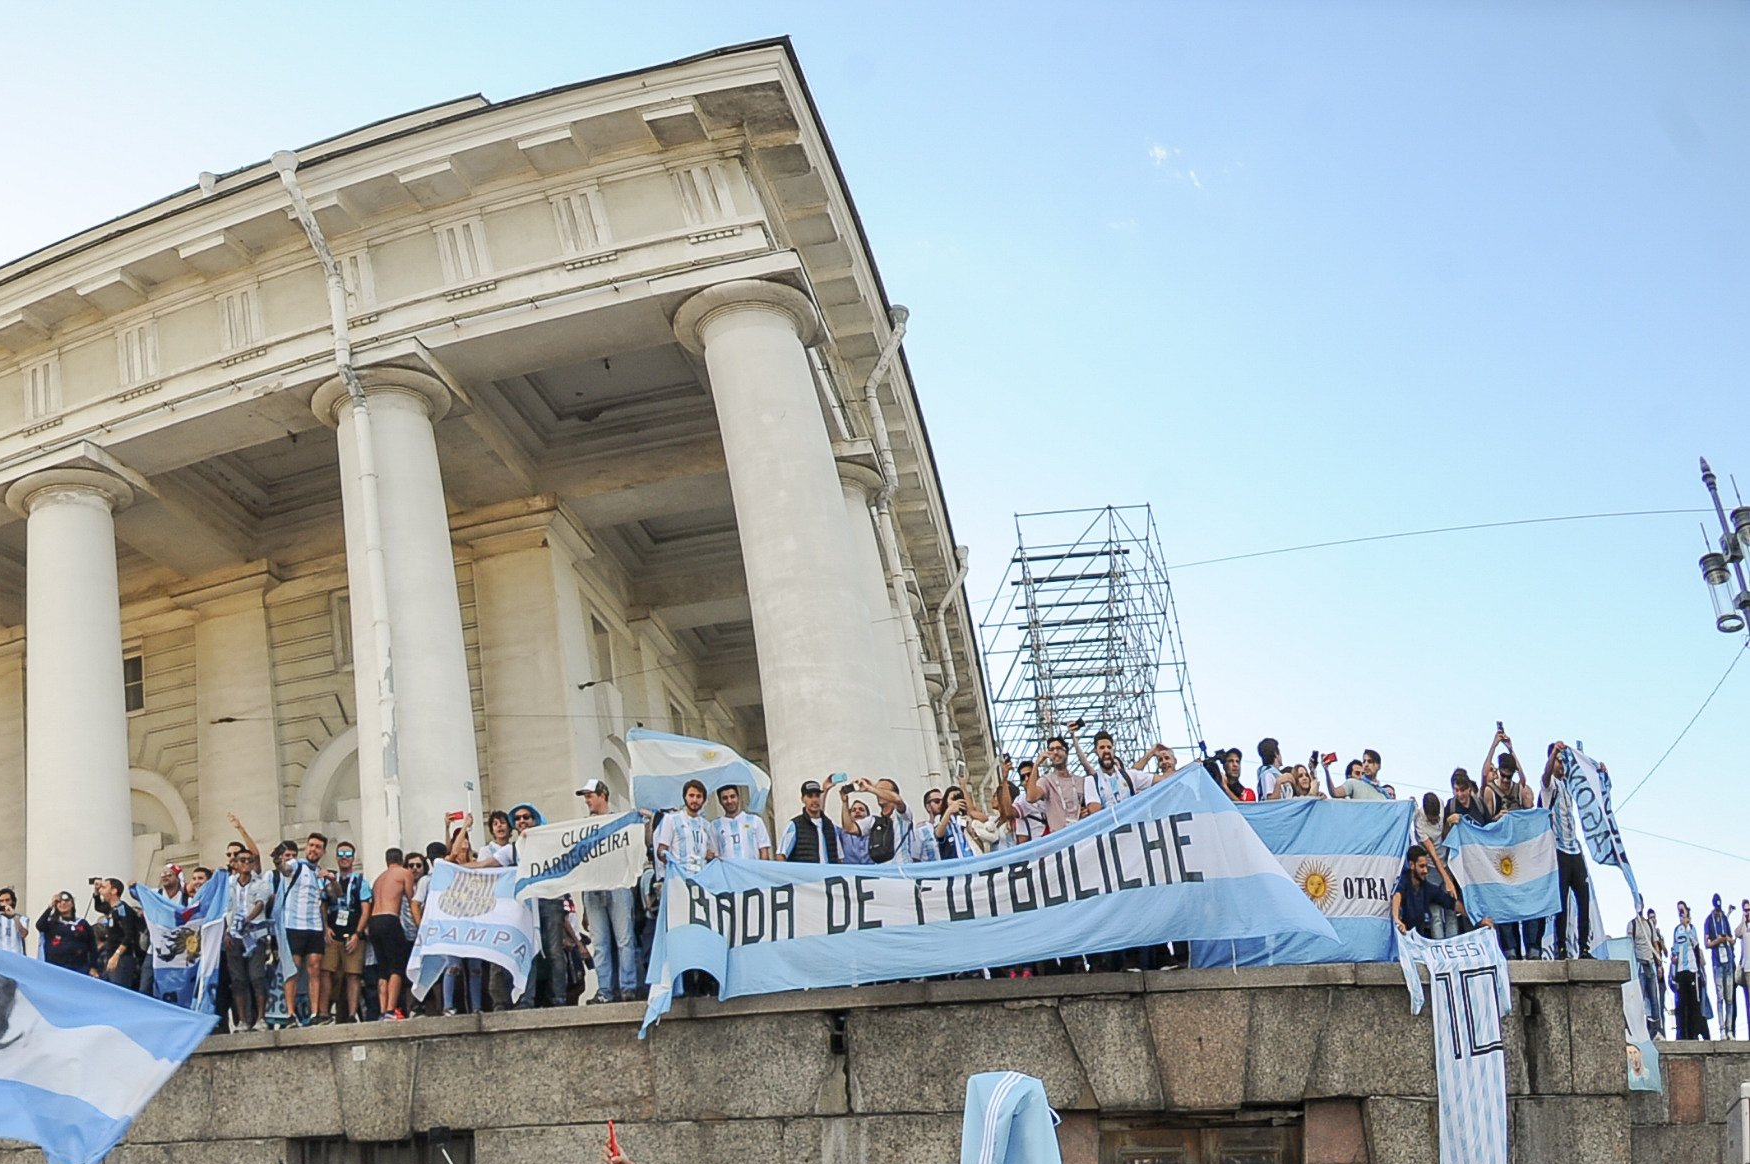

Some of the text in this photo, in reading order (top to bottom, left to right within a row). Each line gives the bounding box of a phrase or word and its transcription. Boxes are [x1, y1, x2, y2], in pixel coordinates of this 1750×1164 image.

[561, 823, 600, 848] CLUB
[530, 831, 630, 878] DARREGUEIRA
[824, 875, 882, 935] DE
[915, 812, 1204, 925] FUTBOLICHE
[1343, 877, 1388, 901] OTRA
[425, 926, 527, 962] PAMPA
[1430, 942, 1486, 960] MESSI
[1435, 964, 1504, 1060] 10
